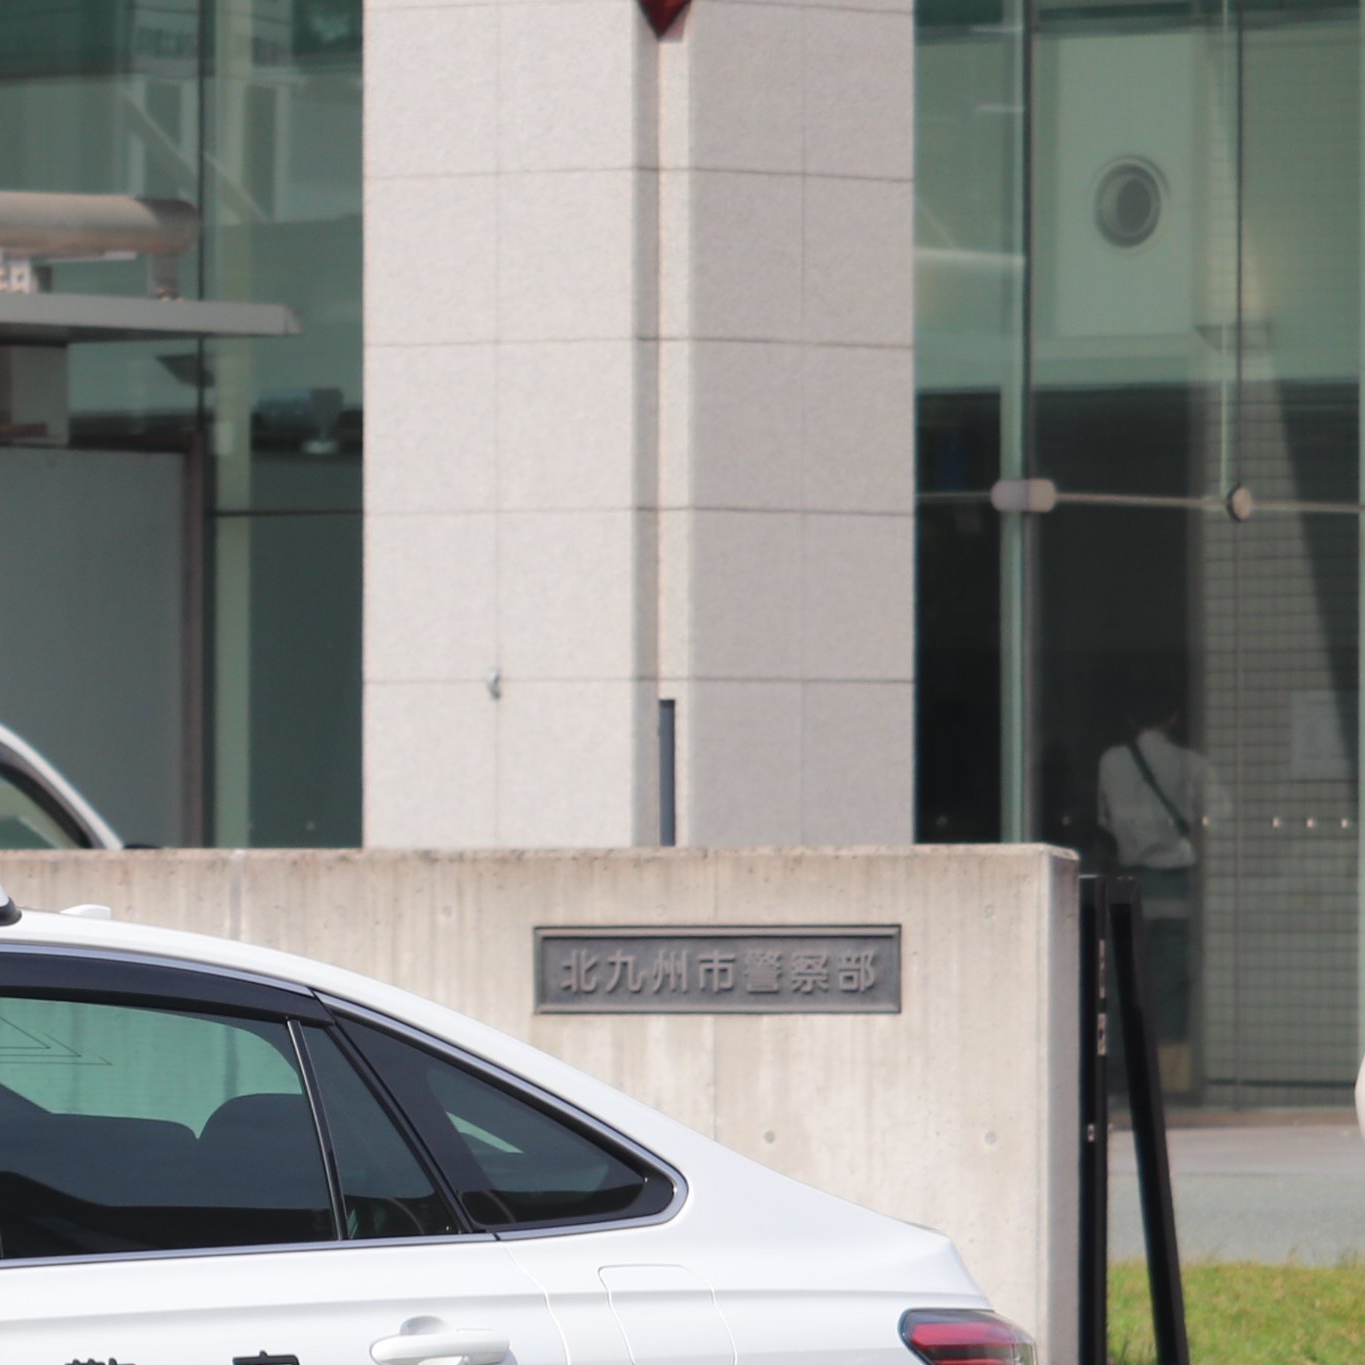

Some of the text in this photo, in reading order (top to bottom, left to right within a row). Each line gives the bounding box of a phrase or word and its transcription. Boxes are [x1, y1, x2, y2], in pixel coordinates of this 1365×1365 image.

[561, 948, 877, 995] 北九州市警察部
